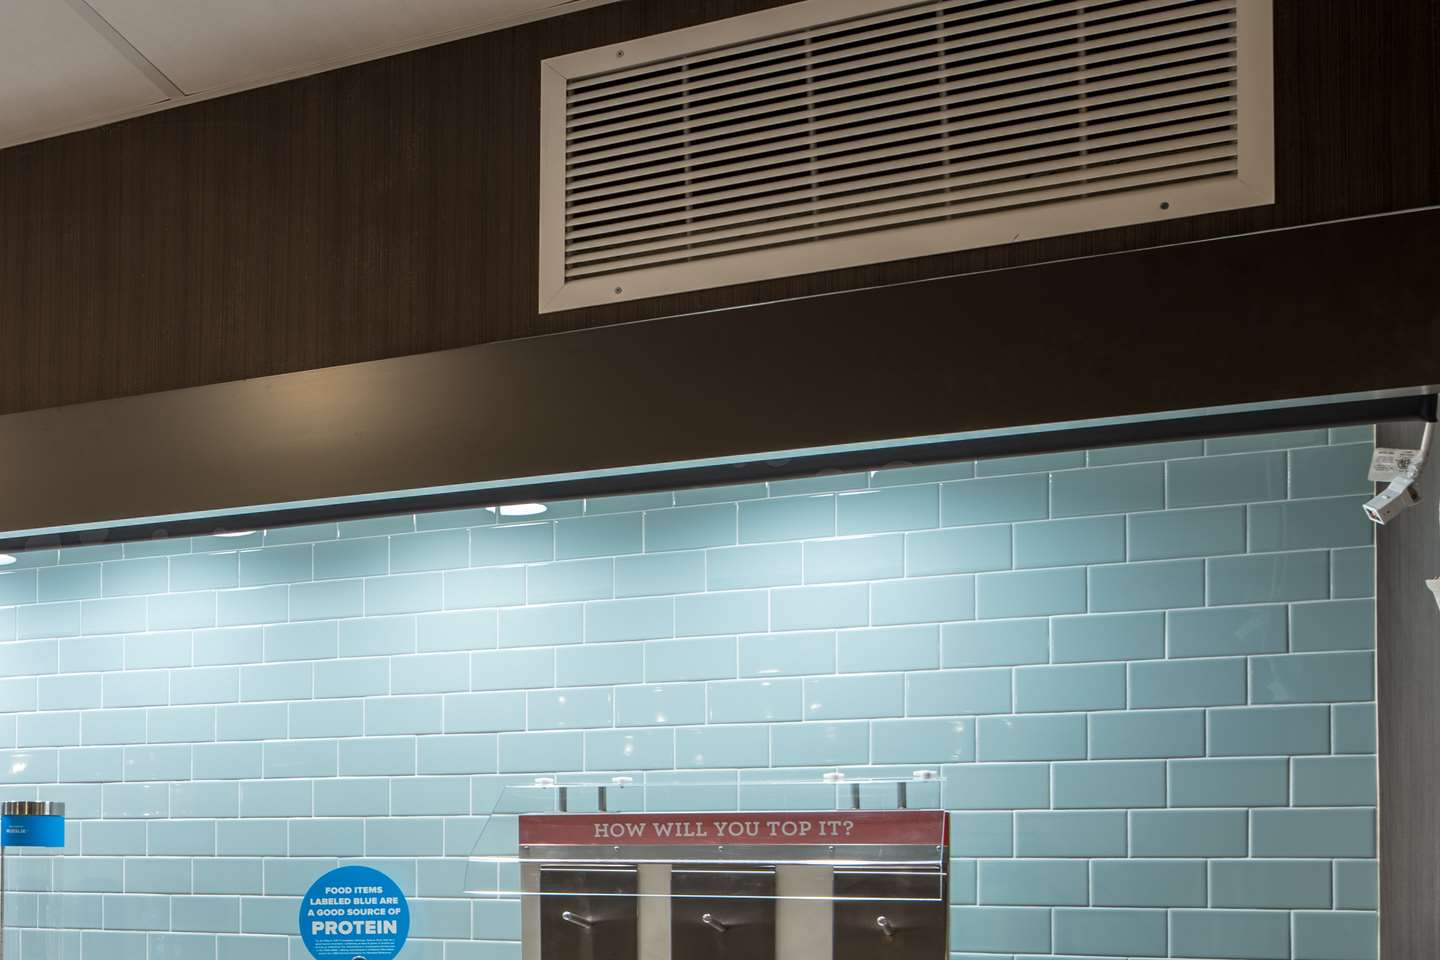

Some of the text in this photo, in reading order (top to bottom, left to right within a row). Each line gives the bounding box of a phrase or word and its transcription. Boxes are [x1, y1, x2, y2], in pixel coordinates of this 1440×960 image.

[594, 820, 855, 838] HOW WILL YOU TOP IT?
[325, 886, 383, 894] FOOD ITEMS
[310, 896, 398, 905] LABELED BLUE ARE
[317, 908, 345, 916] GOOD
[347, 908, 386, 916] SOURCE
[387, 907, 401, 915] OF
[311, 920, 398, 935] PROTEIN
